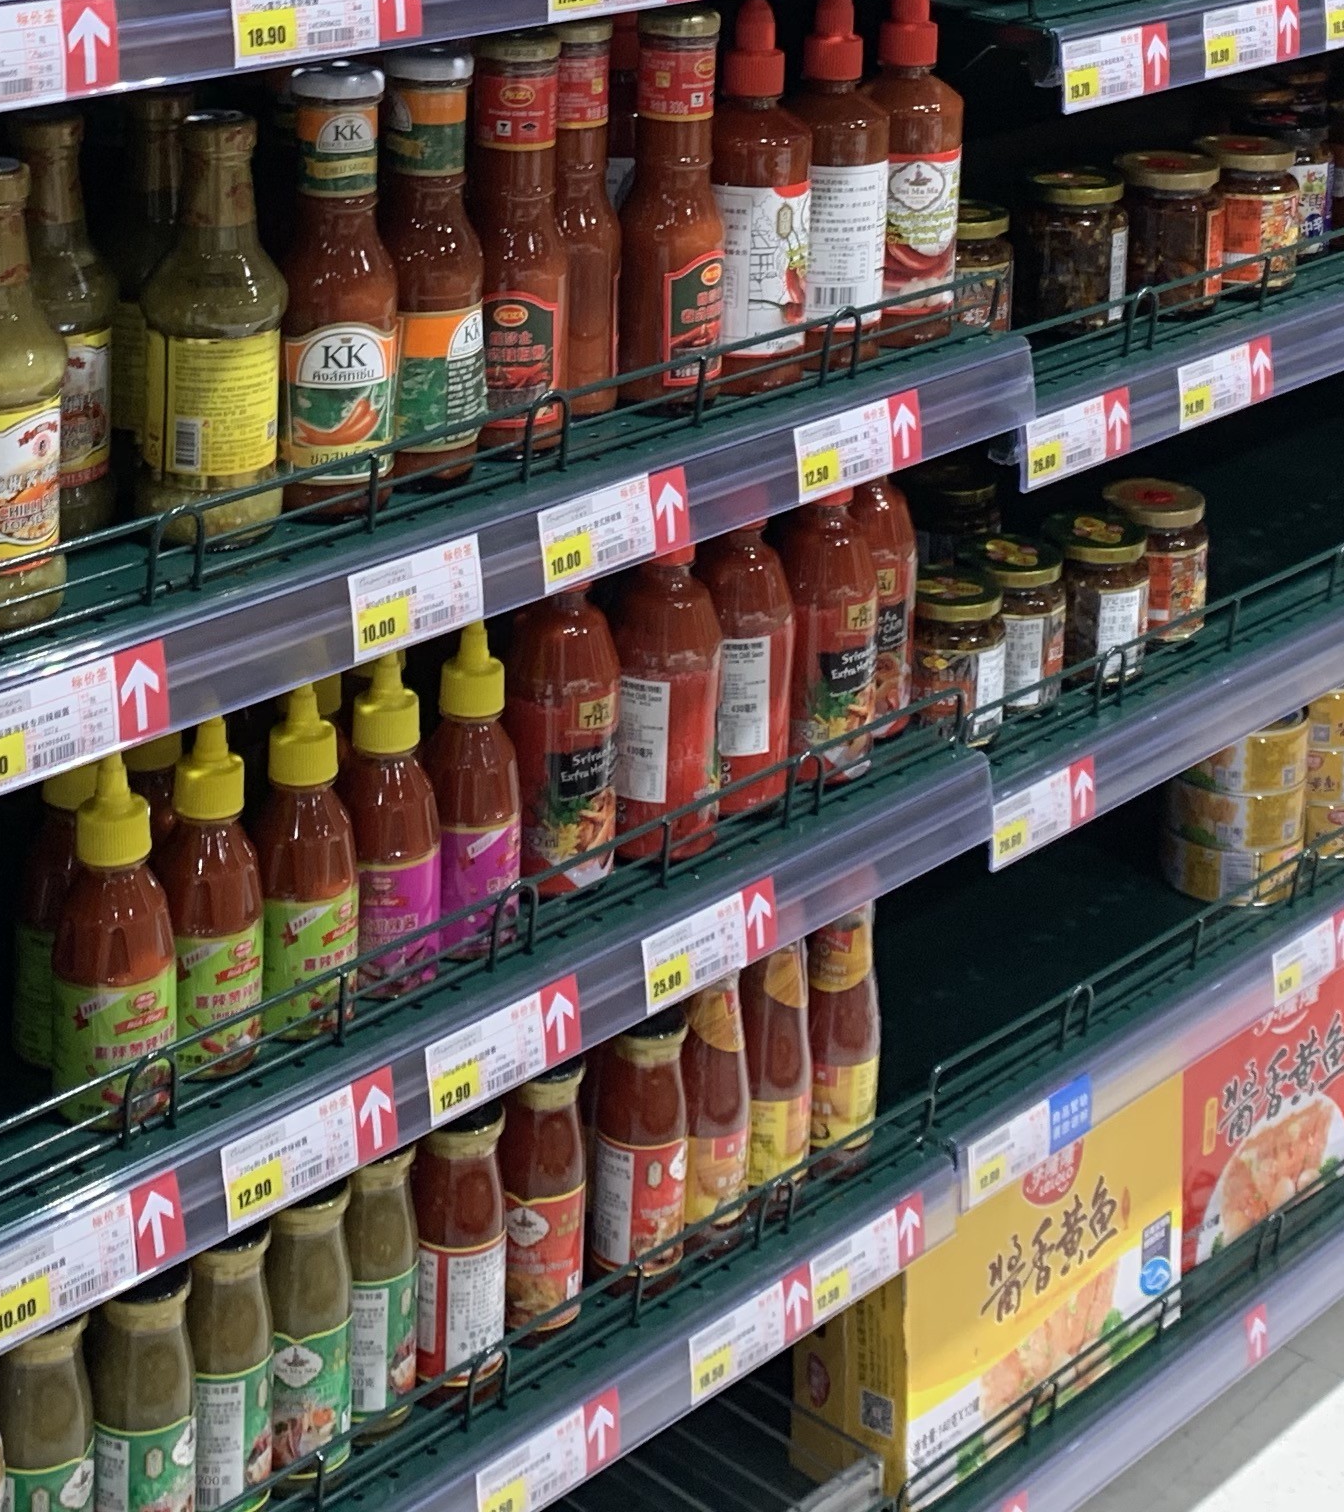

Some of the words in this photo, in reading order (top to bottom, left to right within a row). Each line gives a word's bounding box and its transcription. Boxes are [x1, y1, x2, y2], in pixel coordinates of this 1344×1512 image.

[247, 25, 287, 48] 18.90
[333, 121, 365, 143] KK
[322, 342, 368, 370] KK
[551, 549, 582, 576] 10.00
[362, 616, 396, 644] 10.00
[652, 971, 682, 998] 25.80
[439, 1081, 472, 1112] 12.90
[237, 1177, 273, 1211] 12.90
